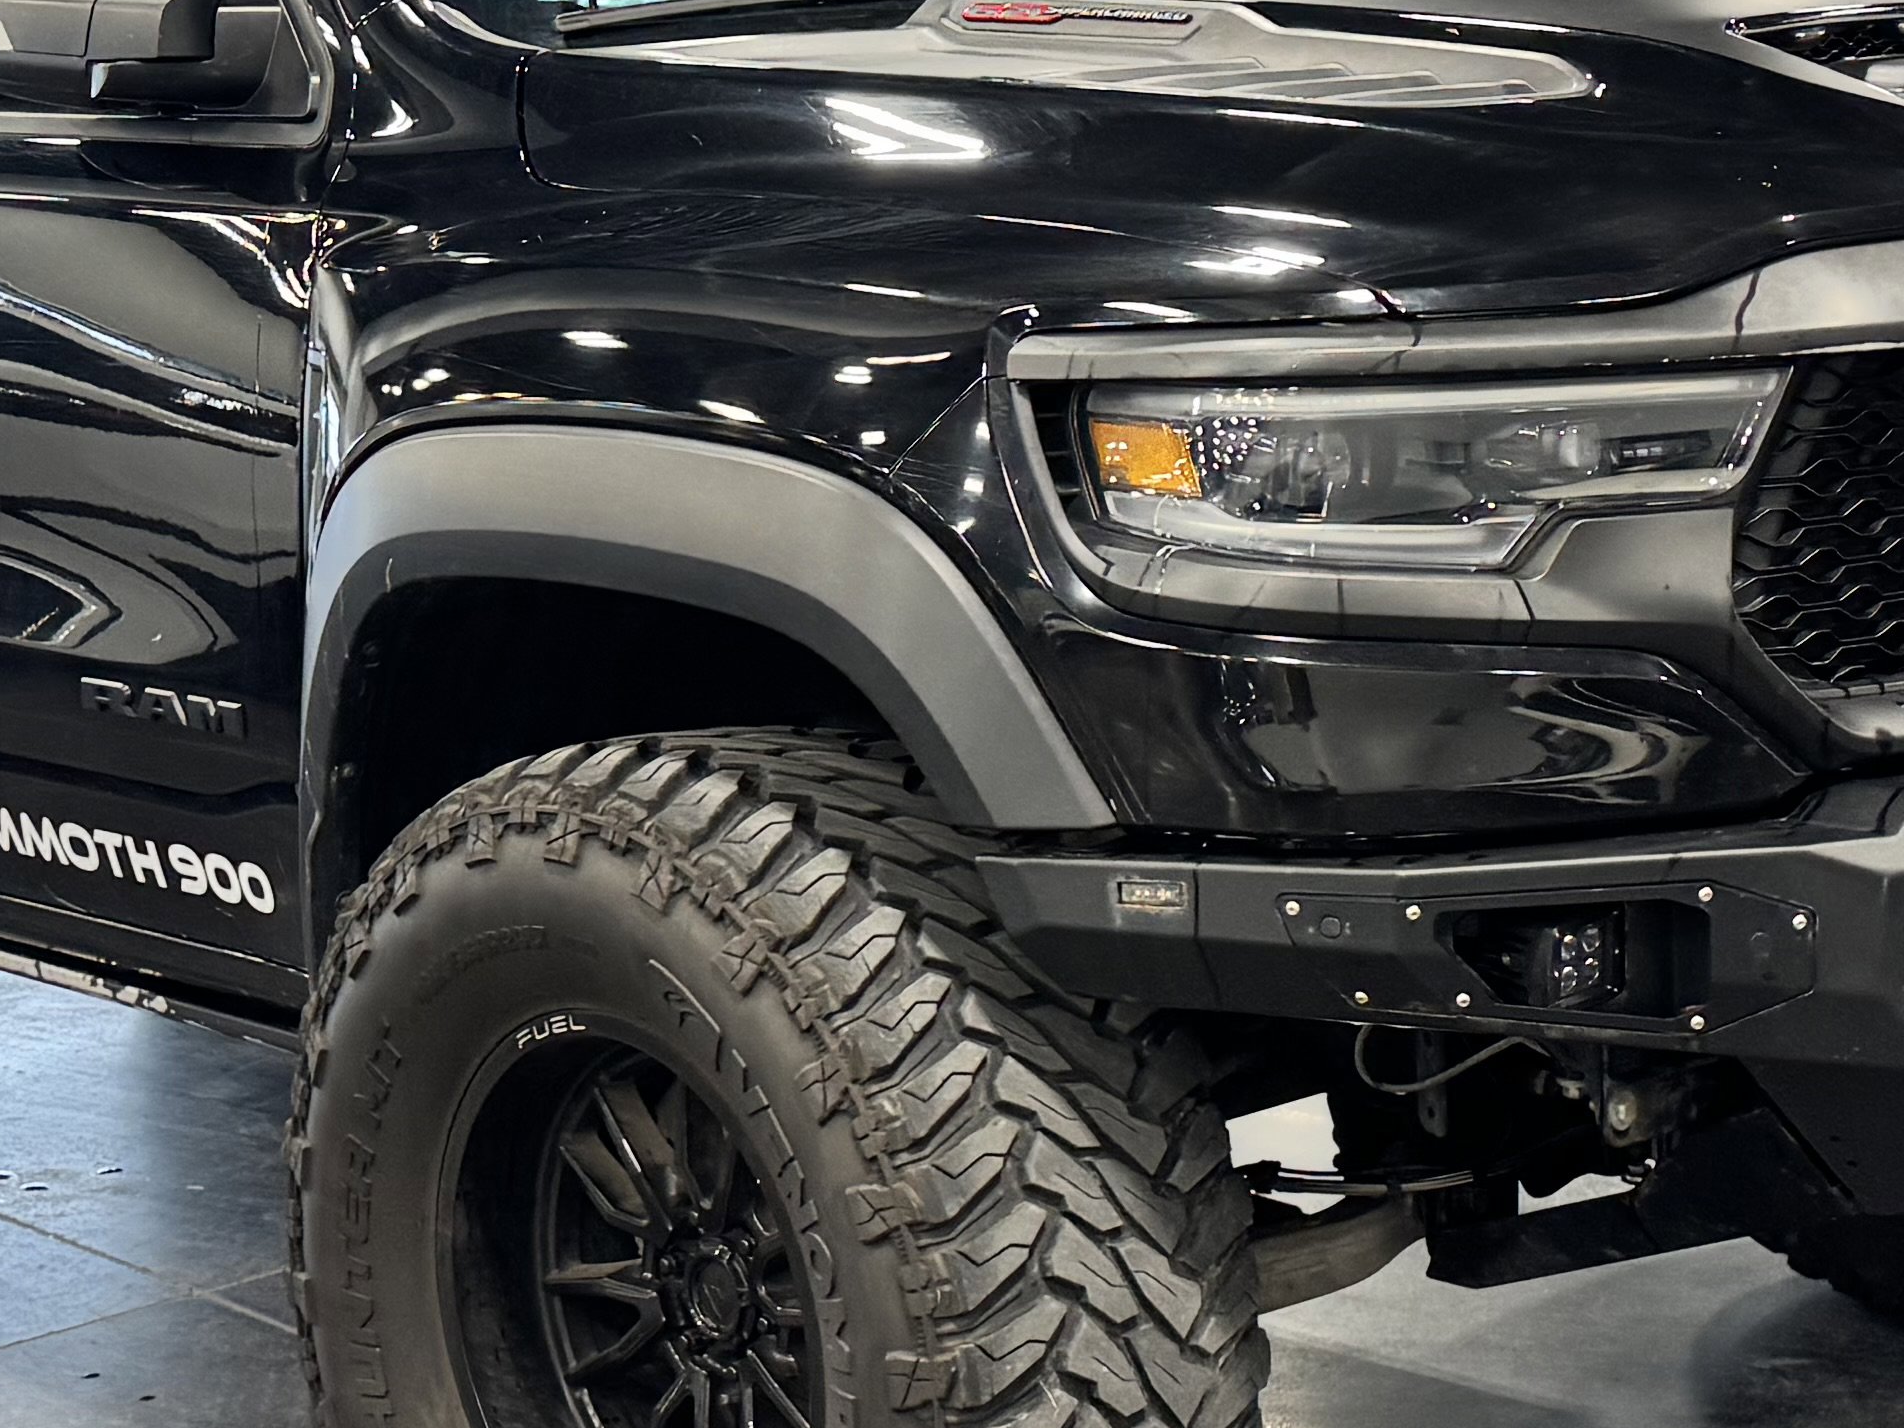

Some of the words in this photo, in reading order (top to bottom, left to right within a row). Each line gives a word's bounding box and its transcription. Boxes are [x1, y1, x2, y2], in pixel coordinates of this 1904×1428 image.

[80, 676, 247, 738] RAM
[168, 843, 275, 914] 900
[516, 1014, 587, 1049] FUEL
